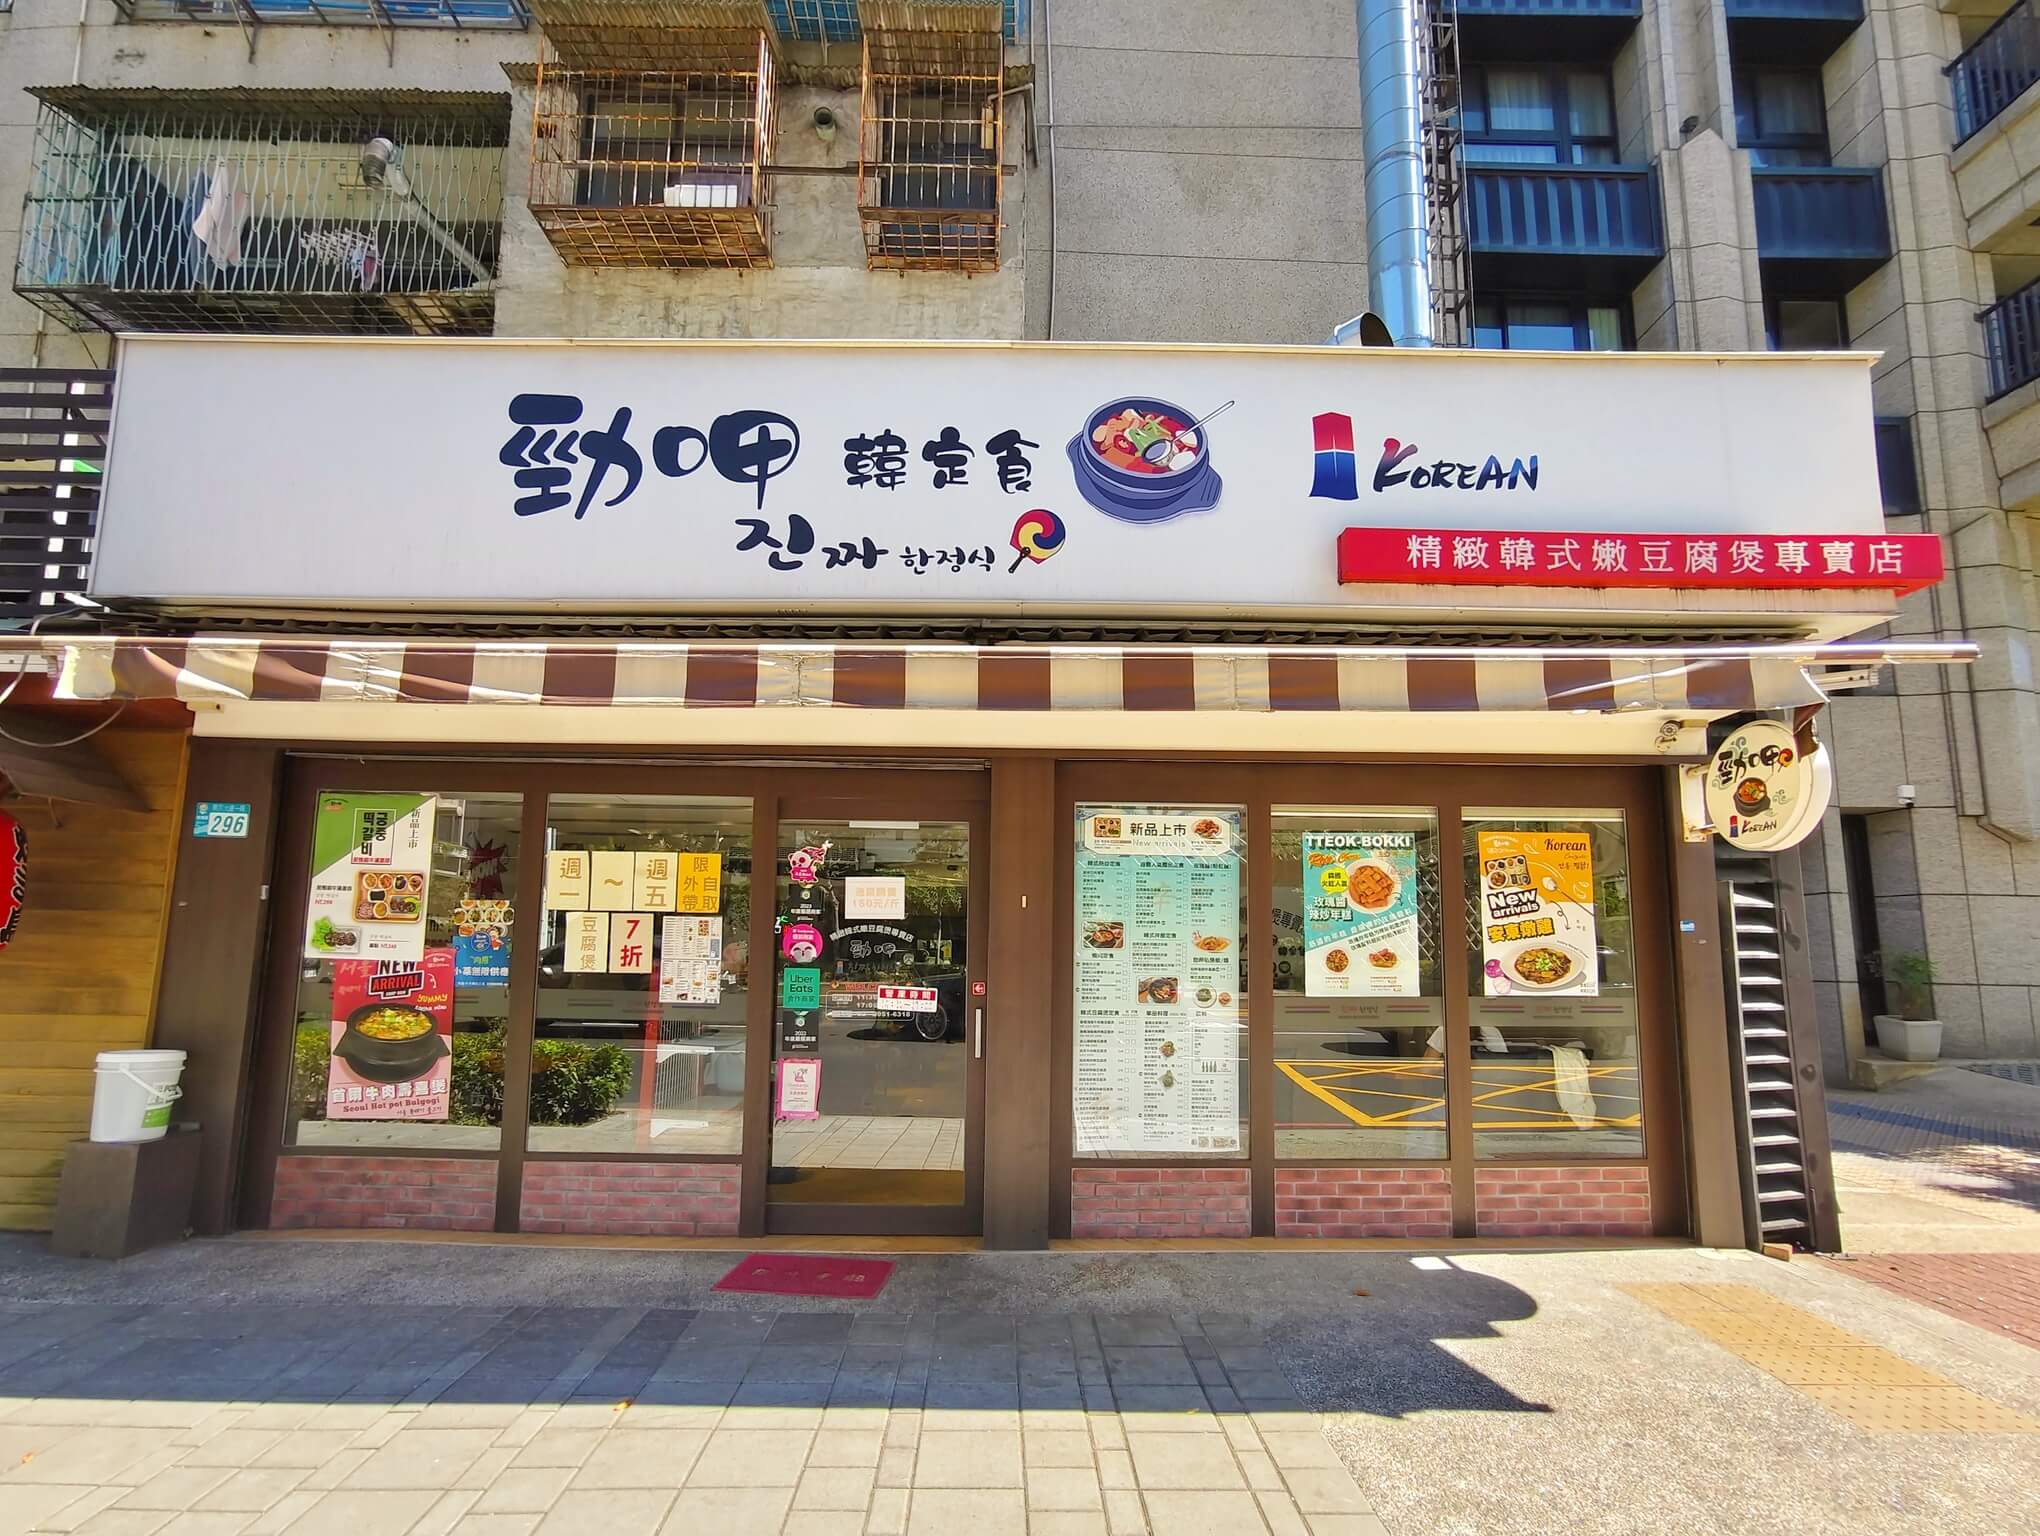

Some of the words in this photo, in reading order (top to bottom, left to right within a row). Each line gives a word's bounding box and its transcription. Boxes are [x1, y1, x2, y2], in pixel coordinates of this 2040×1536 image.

[499, 393, 801, 521] 勁呷
[843, 426, 1041, 494] 韓定食
[735, 514, 889, 571] 진짜
[899, 546, 996, 575] 한정식
[1405, 533, 1904, 575] 精緻韓式嫩豆腐煲專賣店
[210, 815, 245, 834] 296
[408, 808, 421, 849] 新品上市
[1130, 822, 1187, 837] 新品上市
[1305, 835, 1412, 848] TTEOK-BOKKI
[1544, 838, 1587, 851] Korean
[693, 857, 709, 873] 限
[560, 858, 582, 896] 週一
[645, 858, 668, 907] 週五
[1489, 890, 1536, 910] New
[1493, 903, 1539, 917] arrivals
[580, 916, 598, 970] 豆腐煲
[620, 919, 643, 967] 7折
[379, 960, 416, 975] NEW
[372, 974, 420, 991] ARRIVAL
[789, 983, 814, 993] Eats
[790, 974, 814, 984] Uber
[343, 1103, 369, 1113] Seoul
[371, 1100, 387, 1110] Hot
[388, 1099, 403, 1109] pot
